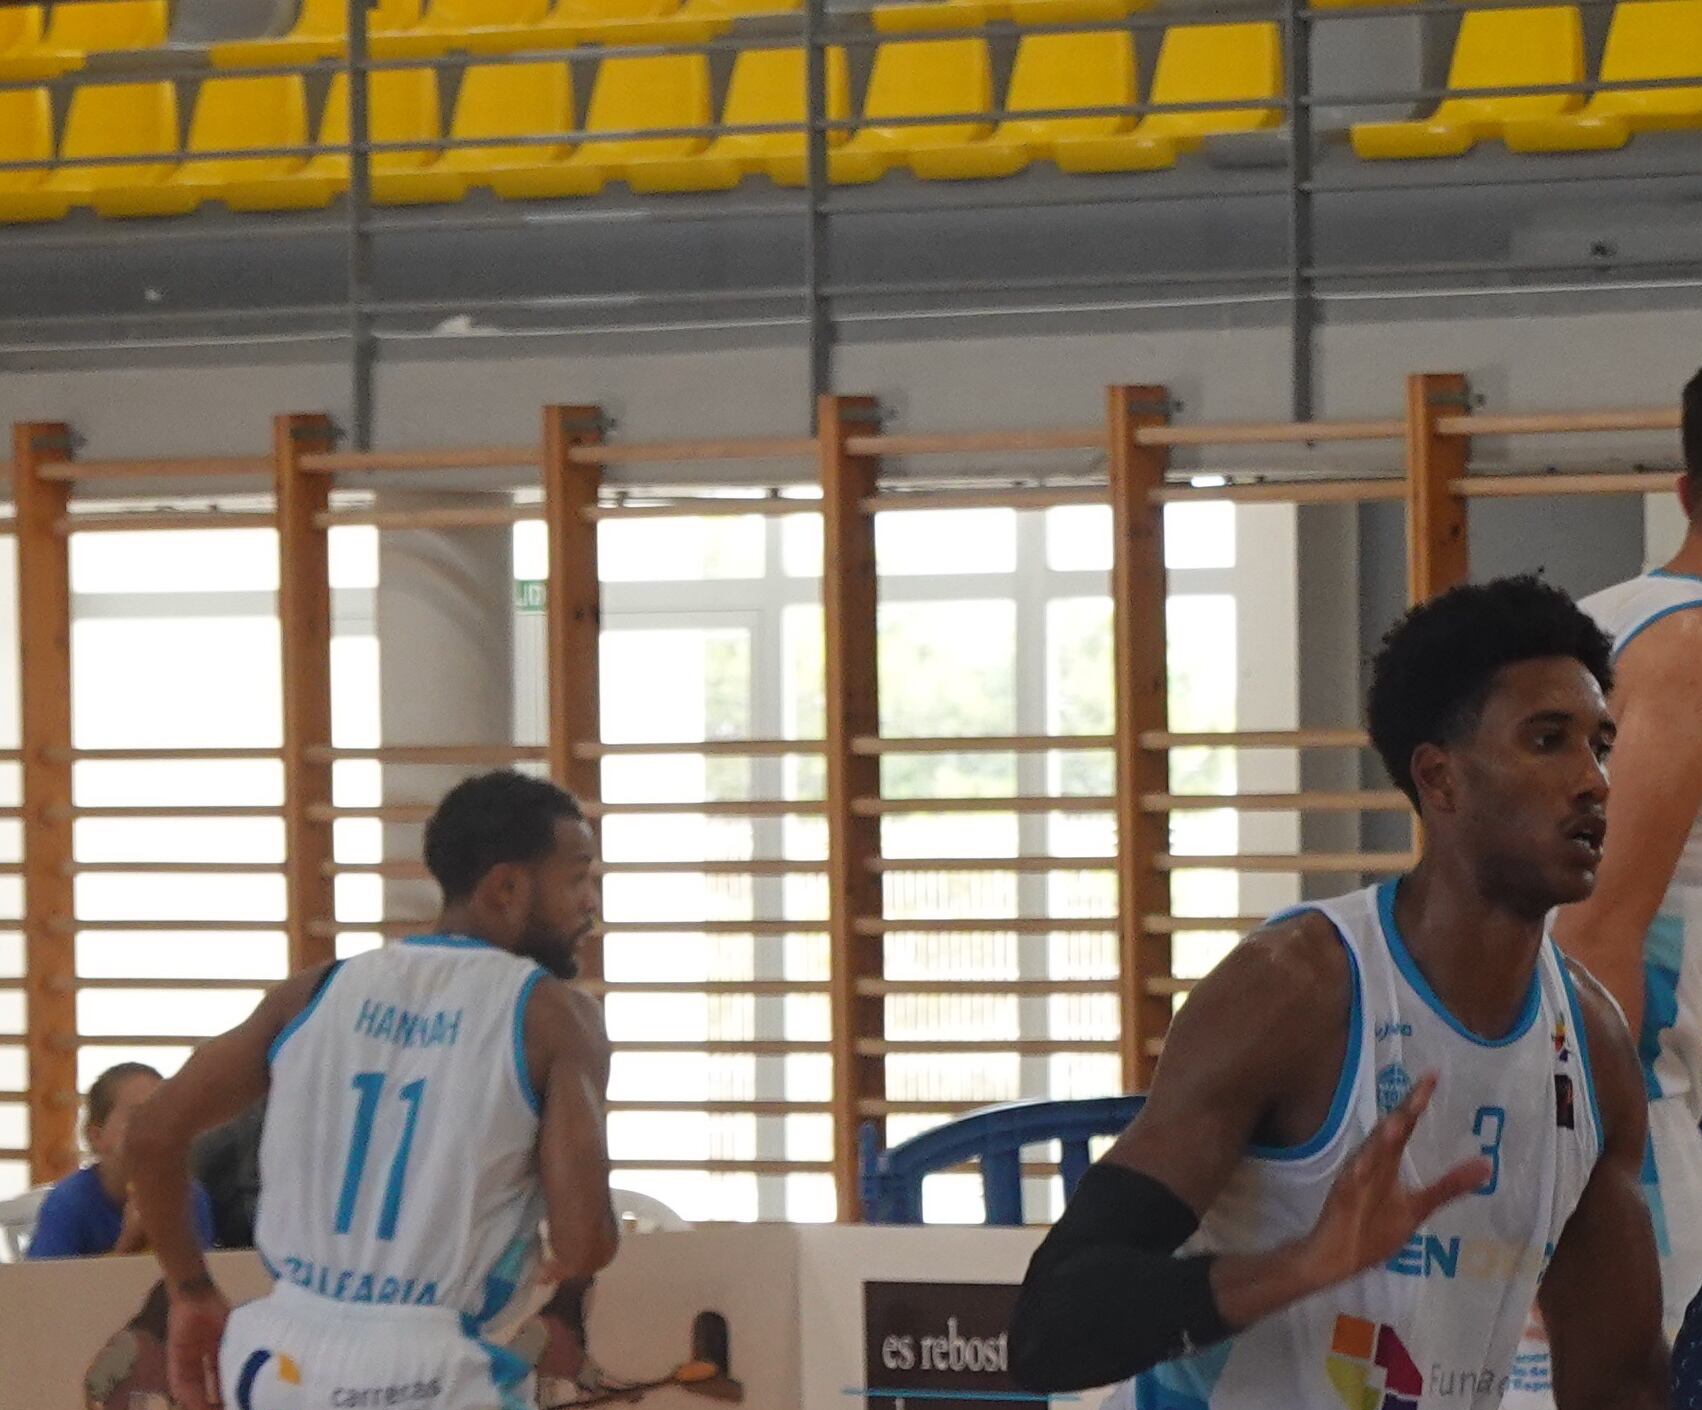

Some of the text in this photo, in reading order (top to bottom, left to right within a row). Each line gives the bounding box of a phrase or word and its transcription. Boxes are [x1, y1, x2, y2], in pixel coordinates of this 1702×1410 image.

[354, 998, 463, 1049] HANNAH
[333, 1071, 428, 1243] 11
[1472, 1104, 1506, 1196] 3
[882, 1315, 1008, 1372] es rebost
